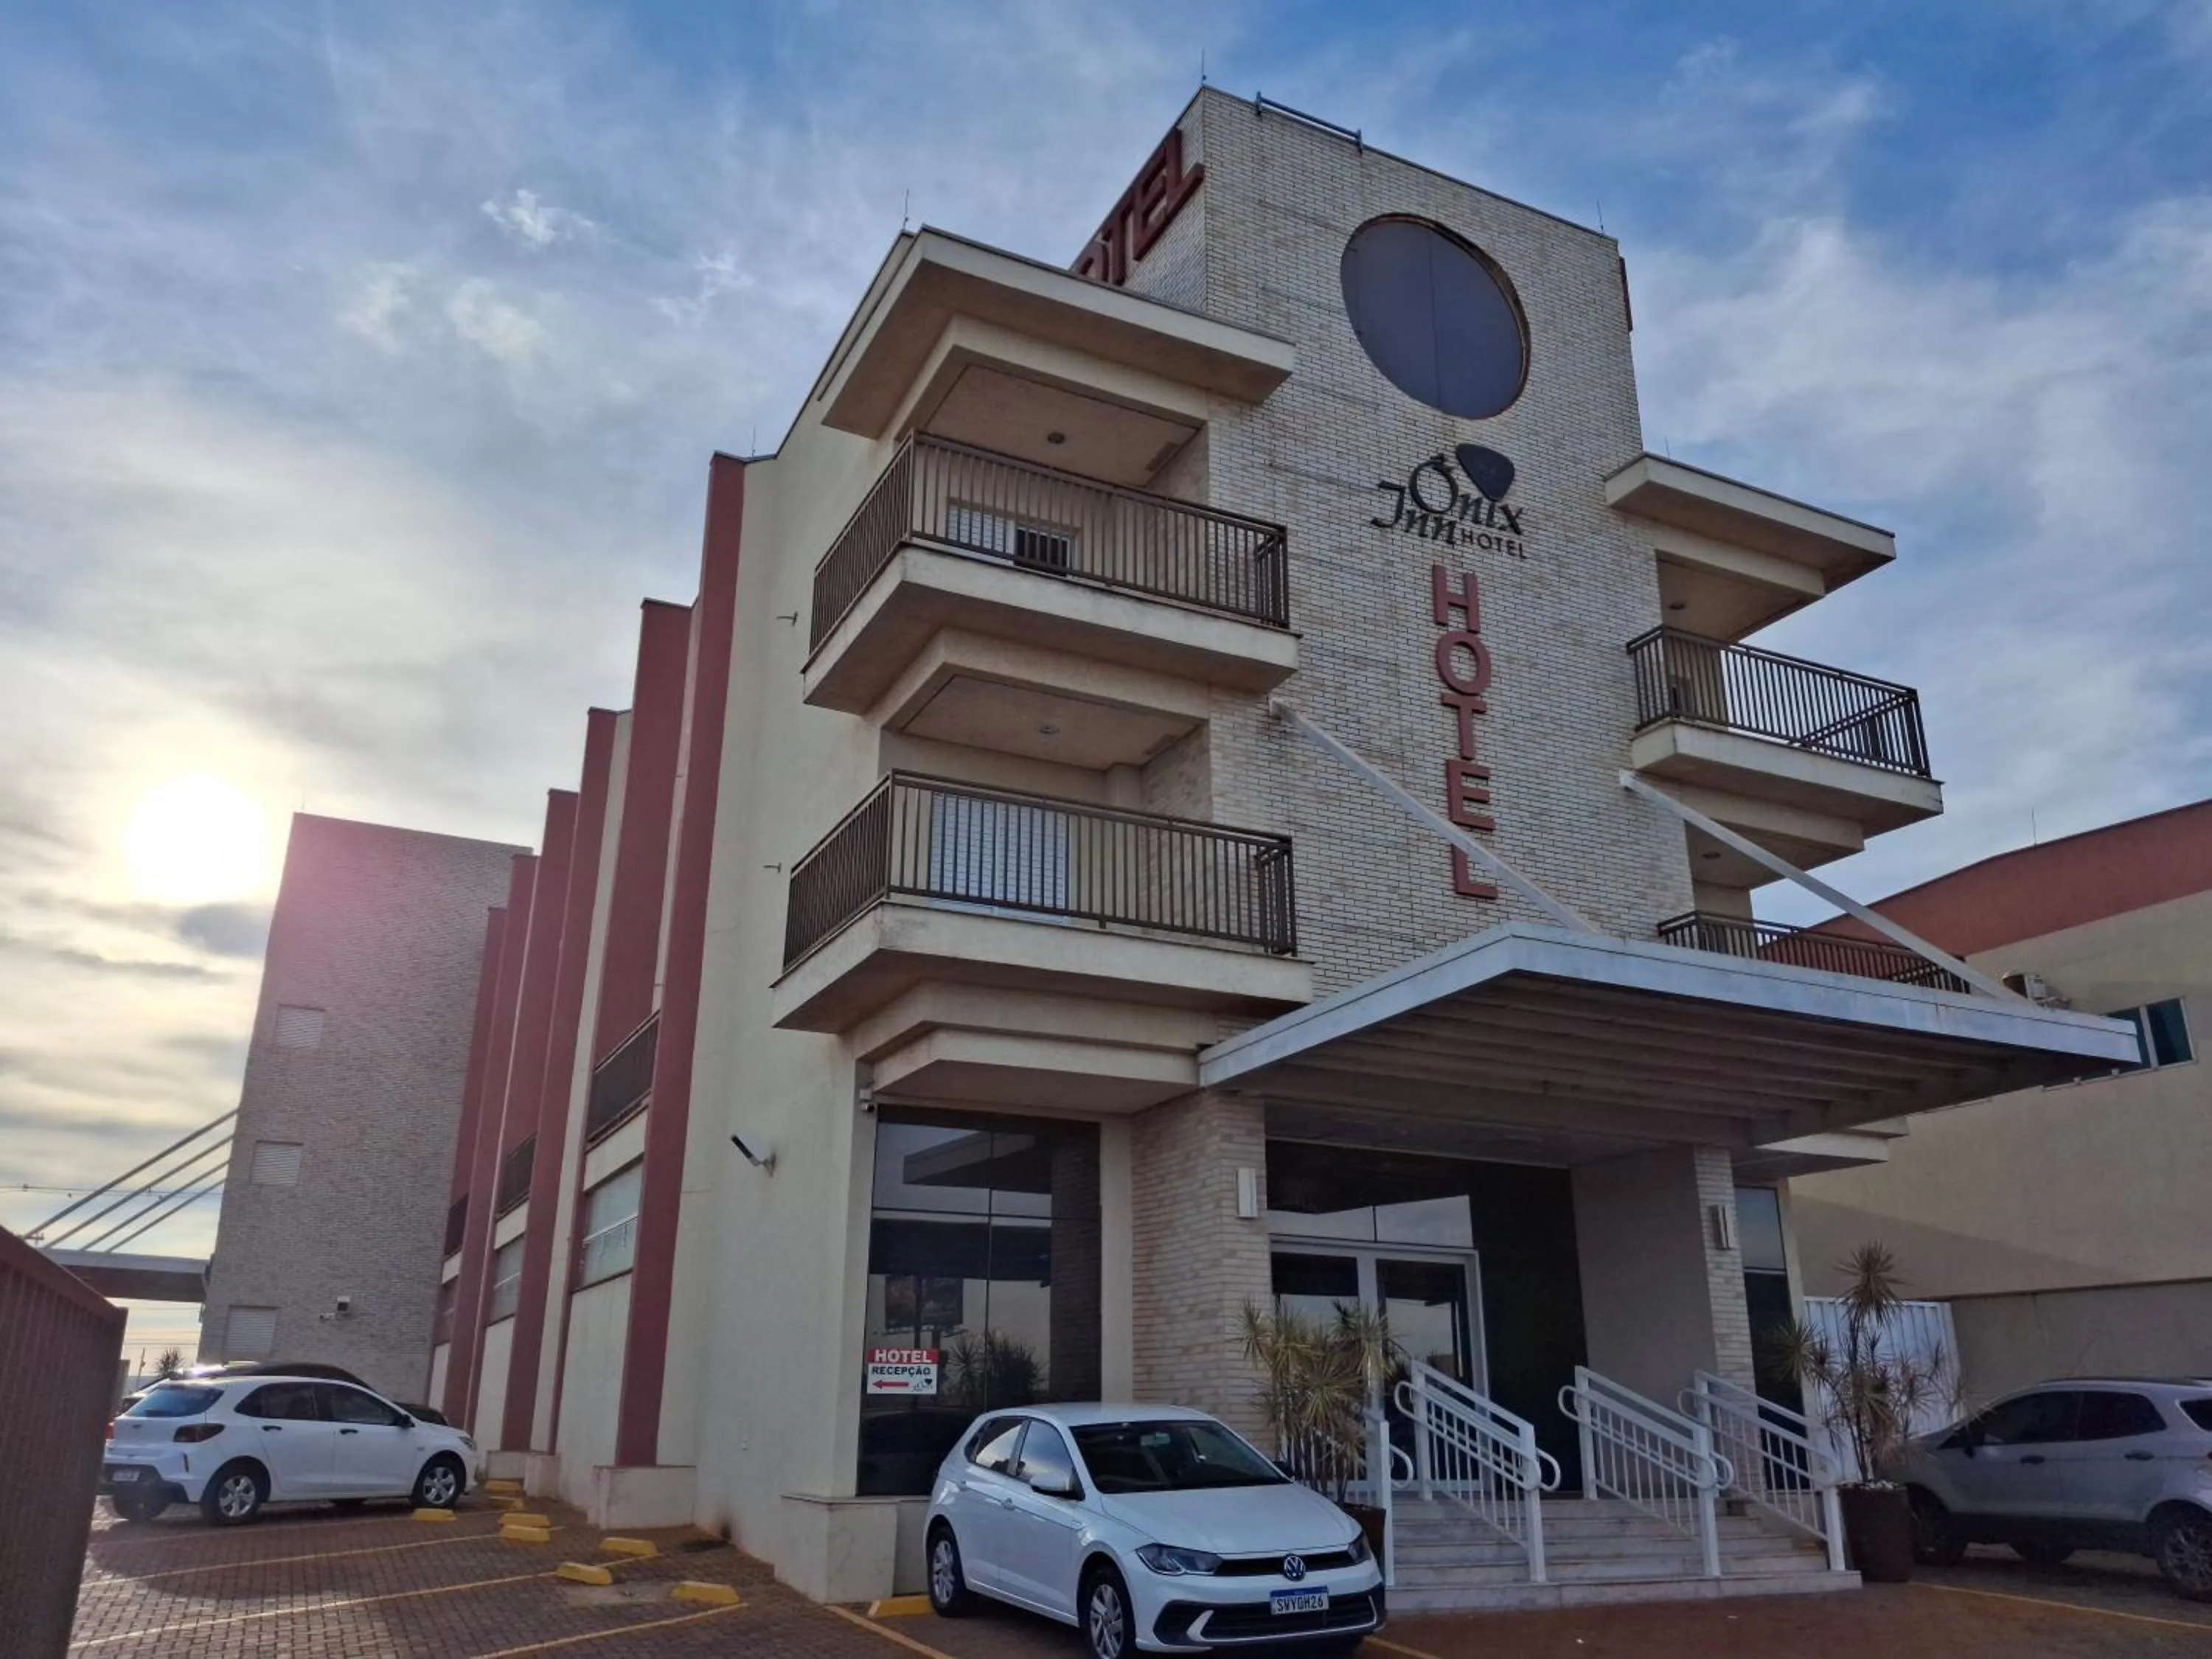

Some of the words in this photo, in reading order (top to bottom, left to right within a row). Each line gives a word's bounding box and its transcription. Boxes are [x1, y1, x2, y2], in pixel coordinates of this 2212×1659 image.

[1071, 125, 1205, 286] OTEL
[1461, 527, 1527, 560] HOTEL
[1431, 564, 1498, 900] HOTEL
[872, 1366, 931, 1378] RECEPÇÃO
[874, 1349, 933, 1363] HOTEL
